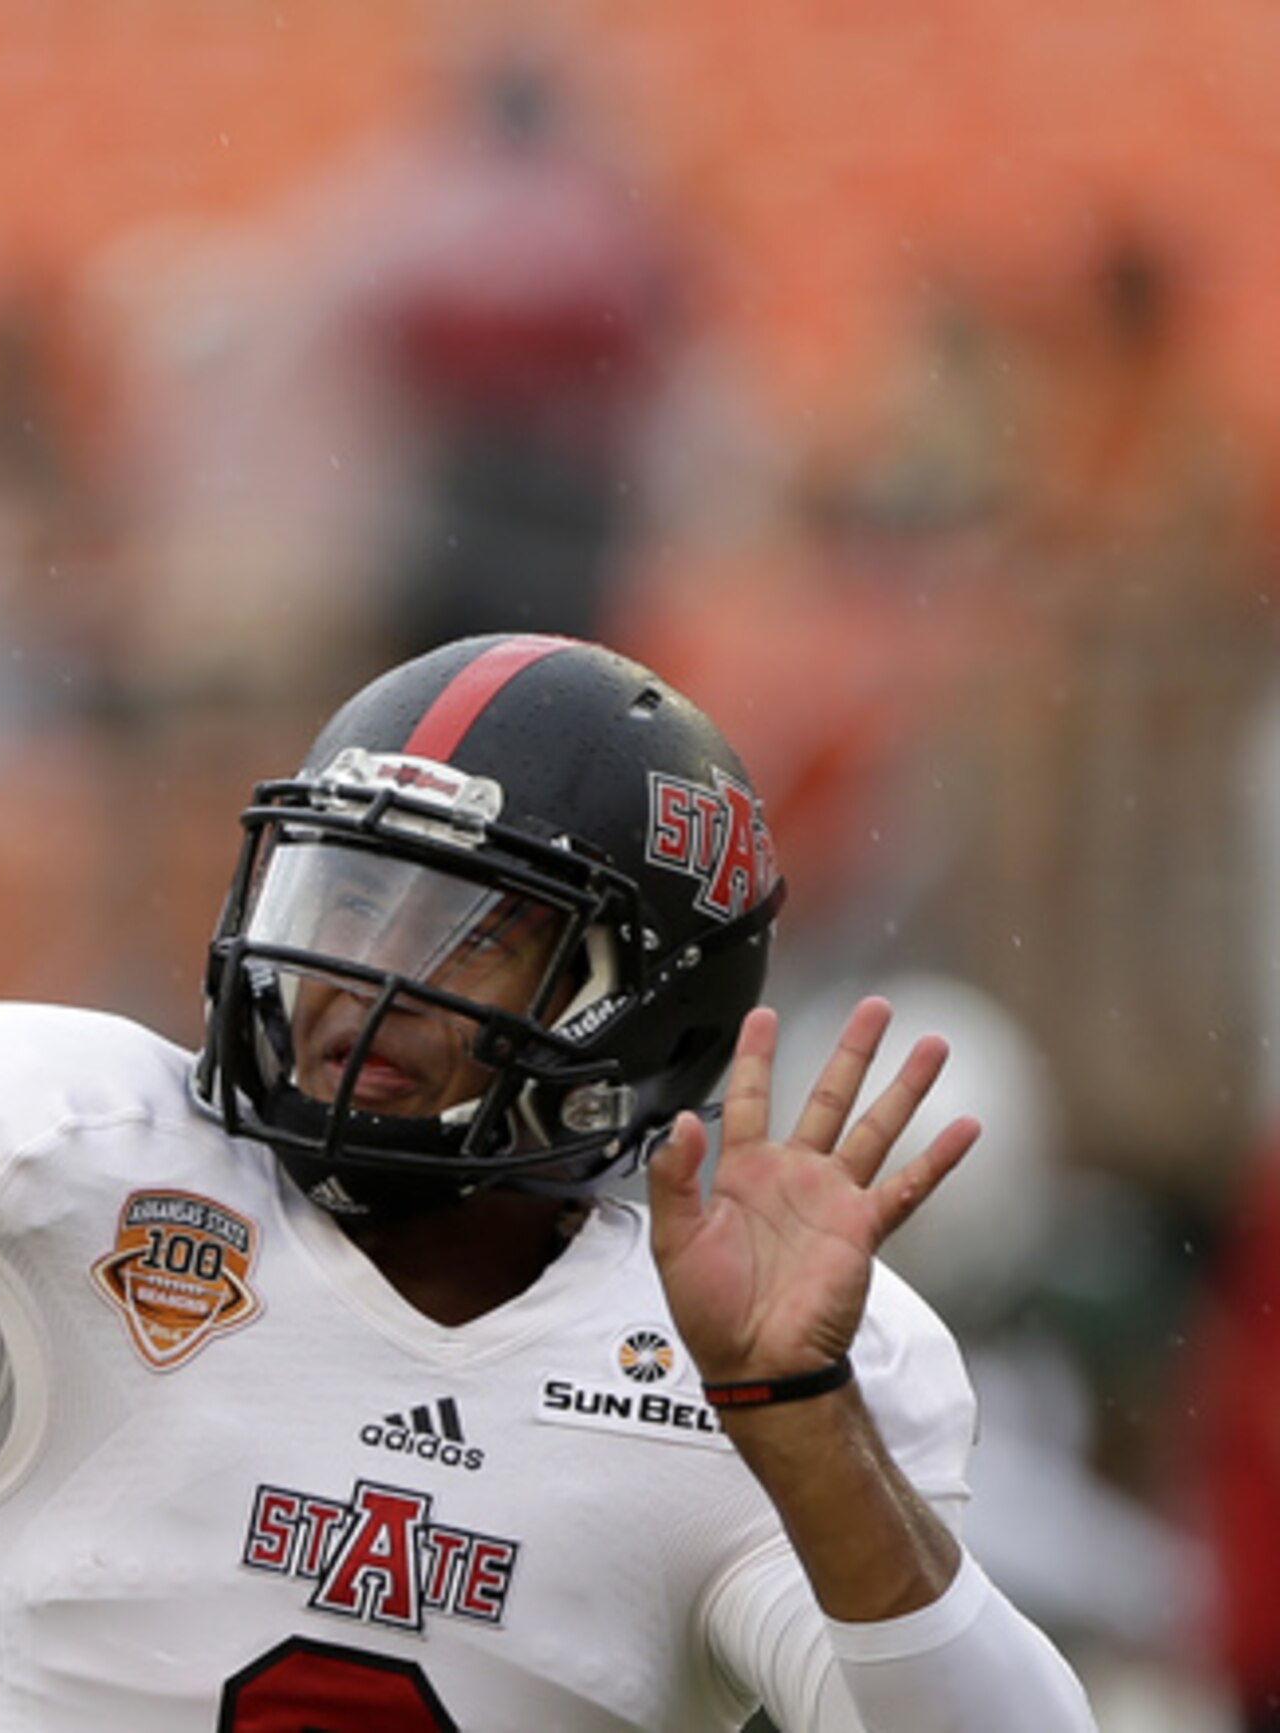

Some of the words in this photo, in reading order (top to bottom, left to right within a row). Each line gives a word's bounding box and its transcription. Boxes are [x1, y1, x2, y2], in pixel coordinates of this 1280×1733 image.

[646, 764, 782, 924] STA
[142, 1230, 223, 1280] 100
[638, 1392, 724, 1434] BEL
[359, 1424, 486, 1471] adidas
[242, 1479, 522, 1632] STATE
